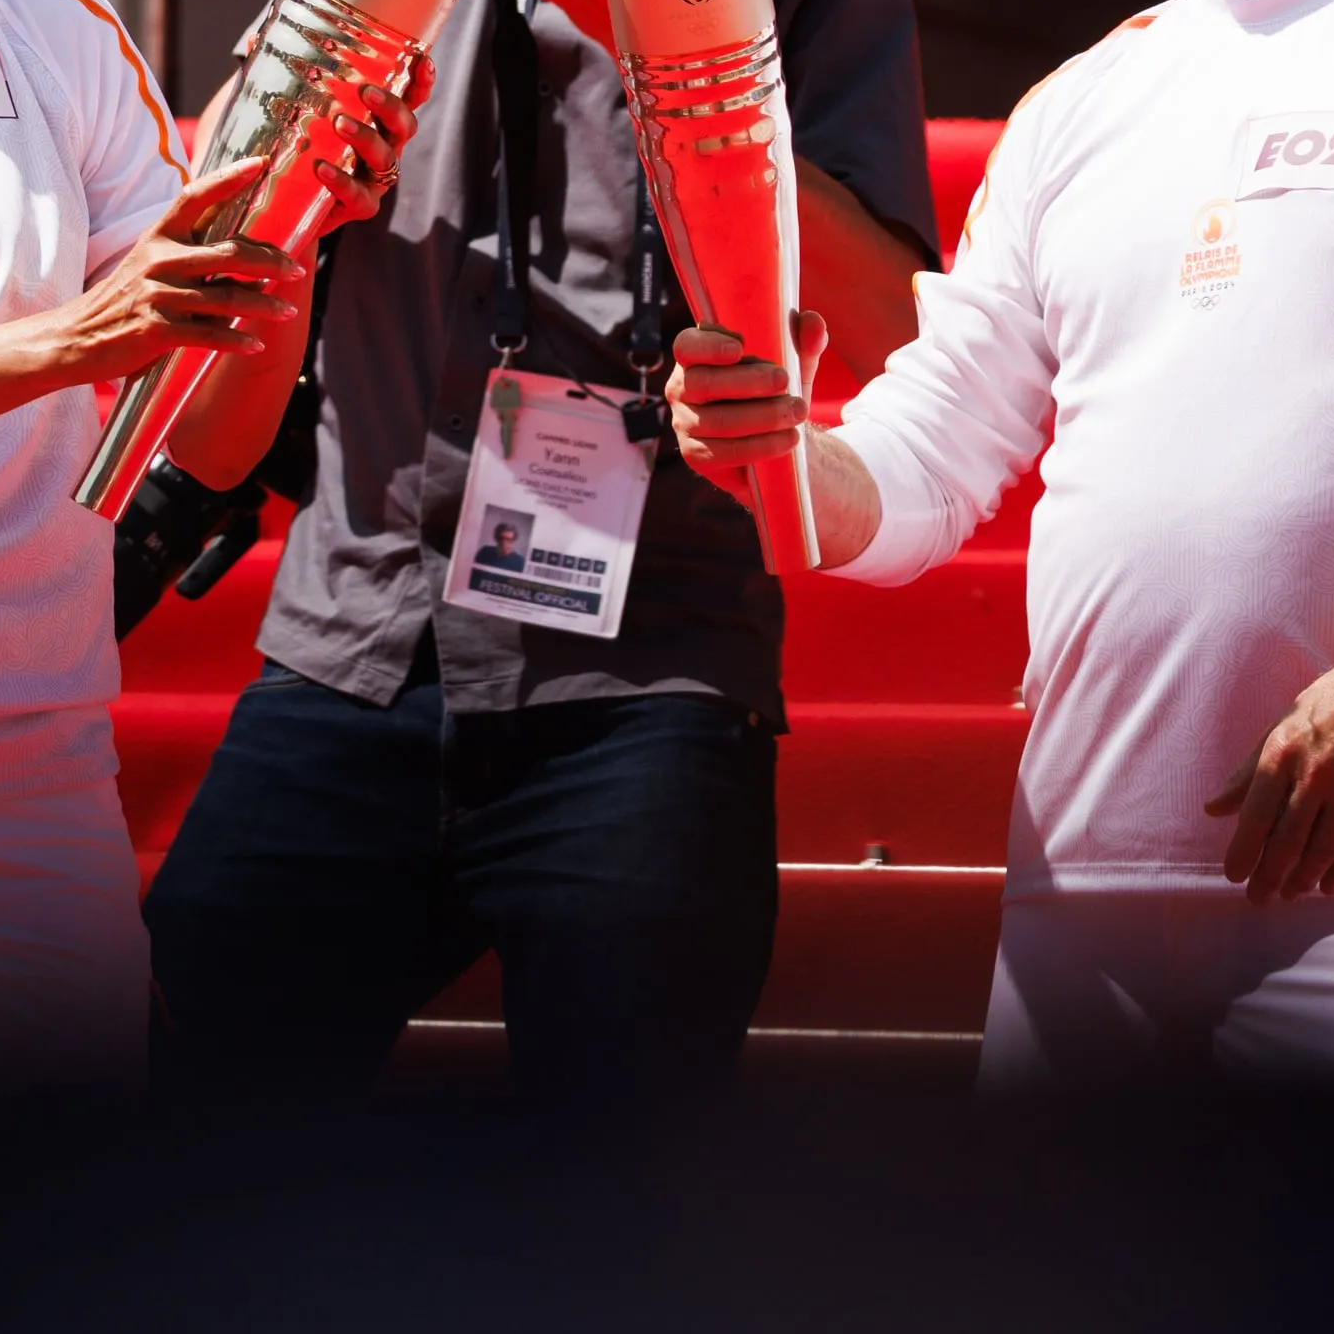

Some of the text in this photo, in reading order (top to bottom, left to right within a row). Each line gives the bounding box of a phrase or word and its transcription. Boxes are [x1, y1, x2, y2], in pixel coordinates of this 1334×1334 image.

[1186, 247, 1222, 263] RELAIS
[1180, 255, 1241, 277] LA FLAMME
[1179, 267, 1241, 286] OLYMPIQUE
